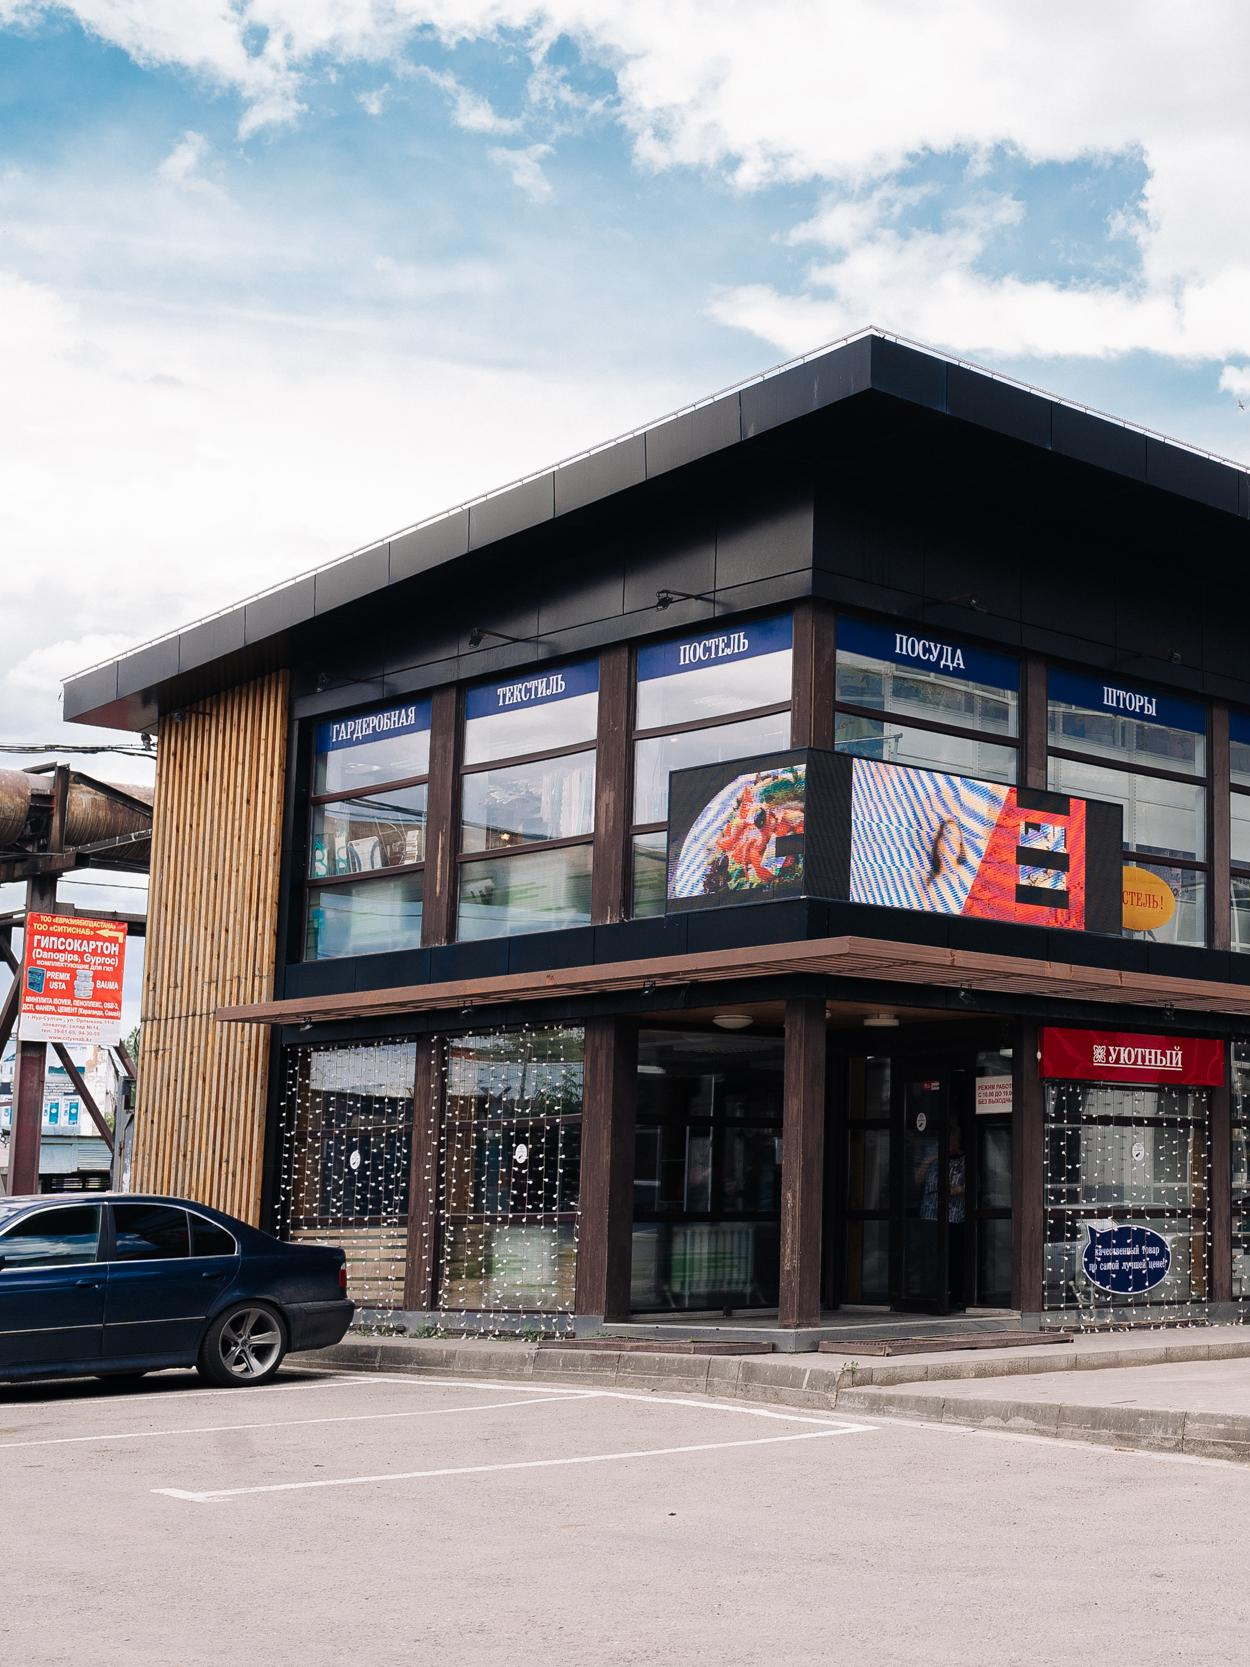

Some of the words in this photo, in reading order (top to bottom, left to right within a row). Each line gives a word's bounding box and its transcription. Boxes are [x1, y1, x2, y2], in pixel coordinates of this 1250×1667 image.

[679, 632, 749, 666] ПОСТЕЛЬ
[895, 633, 966, 671] ПОСУДА
[497, 674, 566, 706] ТЕКСТИЛЬ
[1103, 686, 1158, 717] ШТОРЫ
[332, 707, 417, 743] ГАРДЕРОБНАЯ
[40, 915, 52, 923] ТОО
[33, 923, 48, 931] ТОО
[49, 924, 94, 935] «СИТИСНАБ»
[33, 935, 119, 955] ГИПСОКАРТОН
[32, 948, 81, 963] (Danogips,
[83, 953, 119, 967] Gyproc)
[46, 971, 71, 981] PREMIX
[49, 981, 67, 990] USTA
[96, 980, 119, 990] BAUMA
[1109, 1045, 1183, 1068] УЮТНЫЙ
[1094, 1244, 1140, 1256] качественный
[1141, 1245, 1160, 1256] товар
[1100, 1260, 1120, 1271] самой
[1121, 1259, 1147, 1271] лучшей
